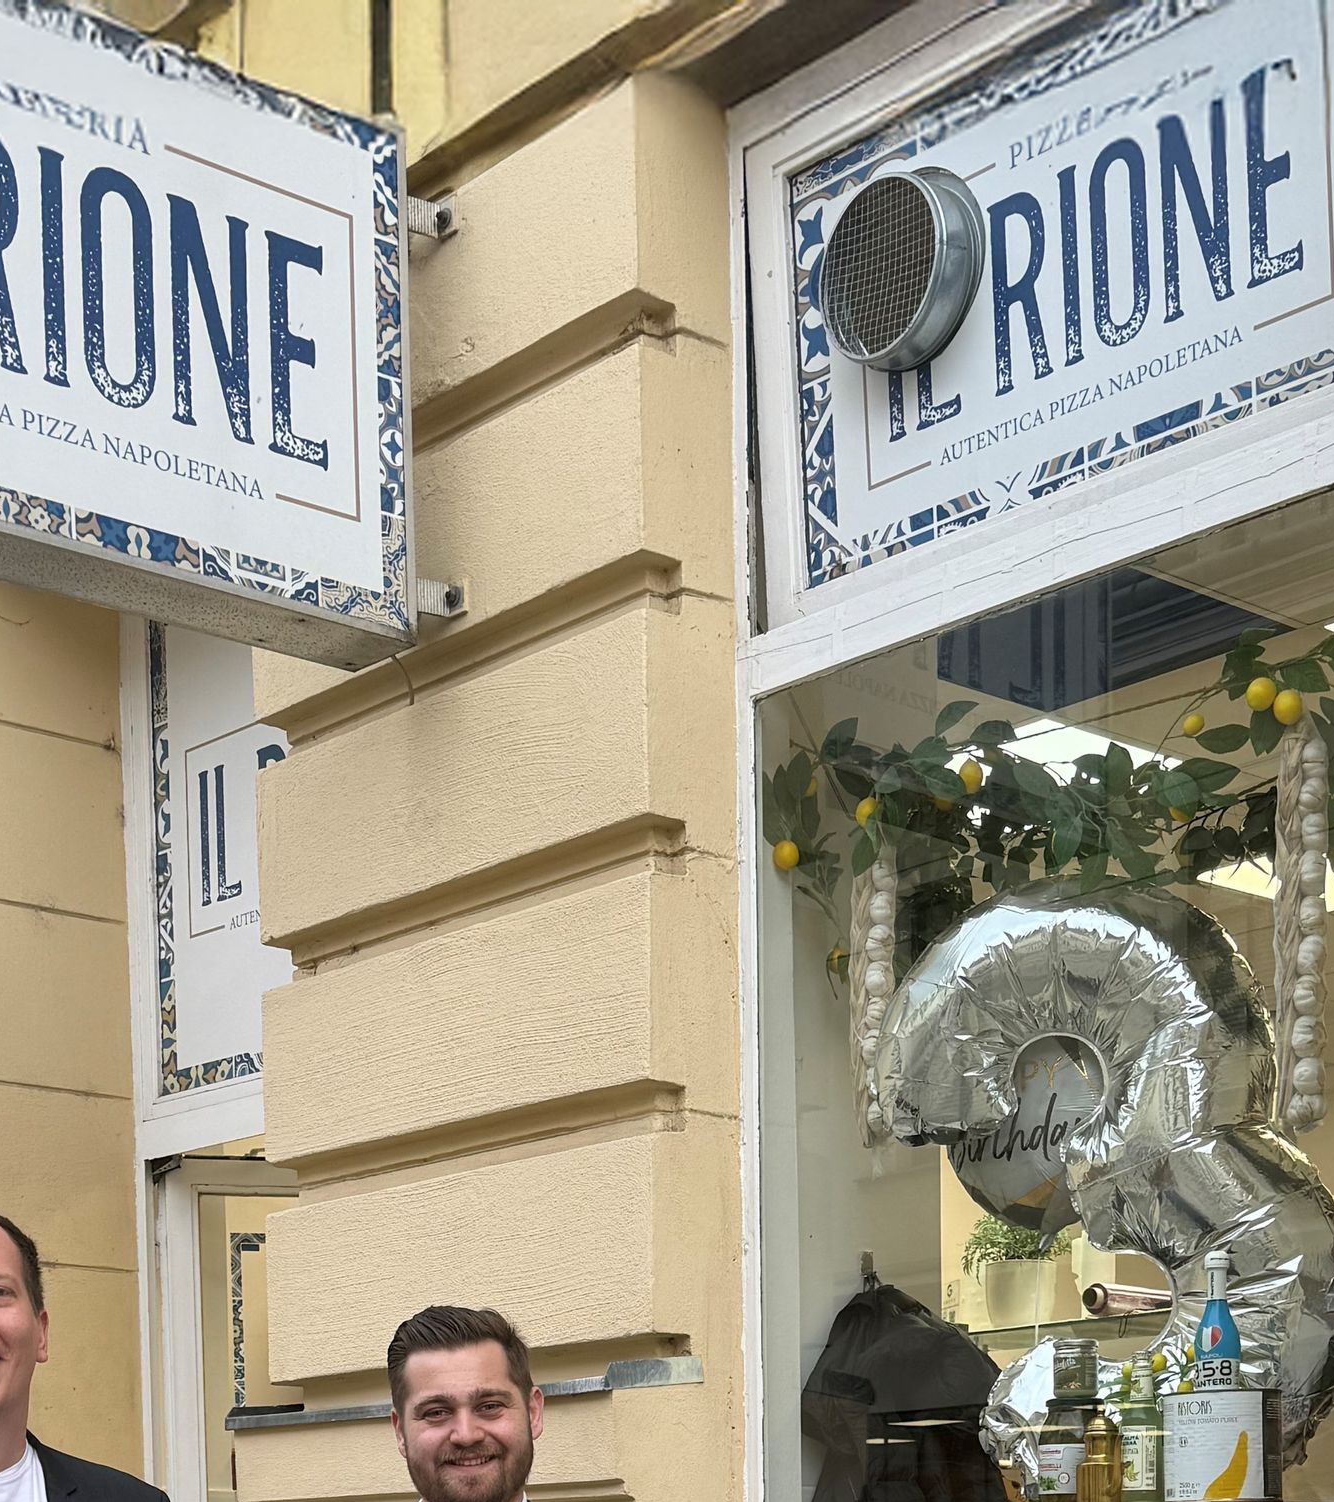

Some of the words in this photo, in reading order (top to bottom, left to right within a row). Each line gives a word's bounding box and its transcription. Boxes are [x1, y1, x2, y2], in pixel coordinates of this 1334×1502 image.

[986, 57, 1304, 397] RIONE
[21, 408, 97, 452] PIZZA
[103, 433, 265, 501] NAPOLETANA
[939, 409, 1046, 466] AUTENTICA
[1049, 385, 1105, 421] PIZZA
[1108, 325, 1244, 396] NAPOLETANA
[198, 764, 243, 907] IL
